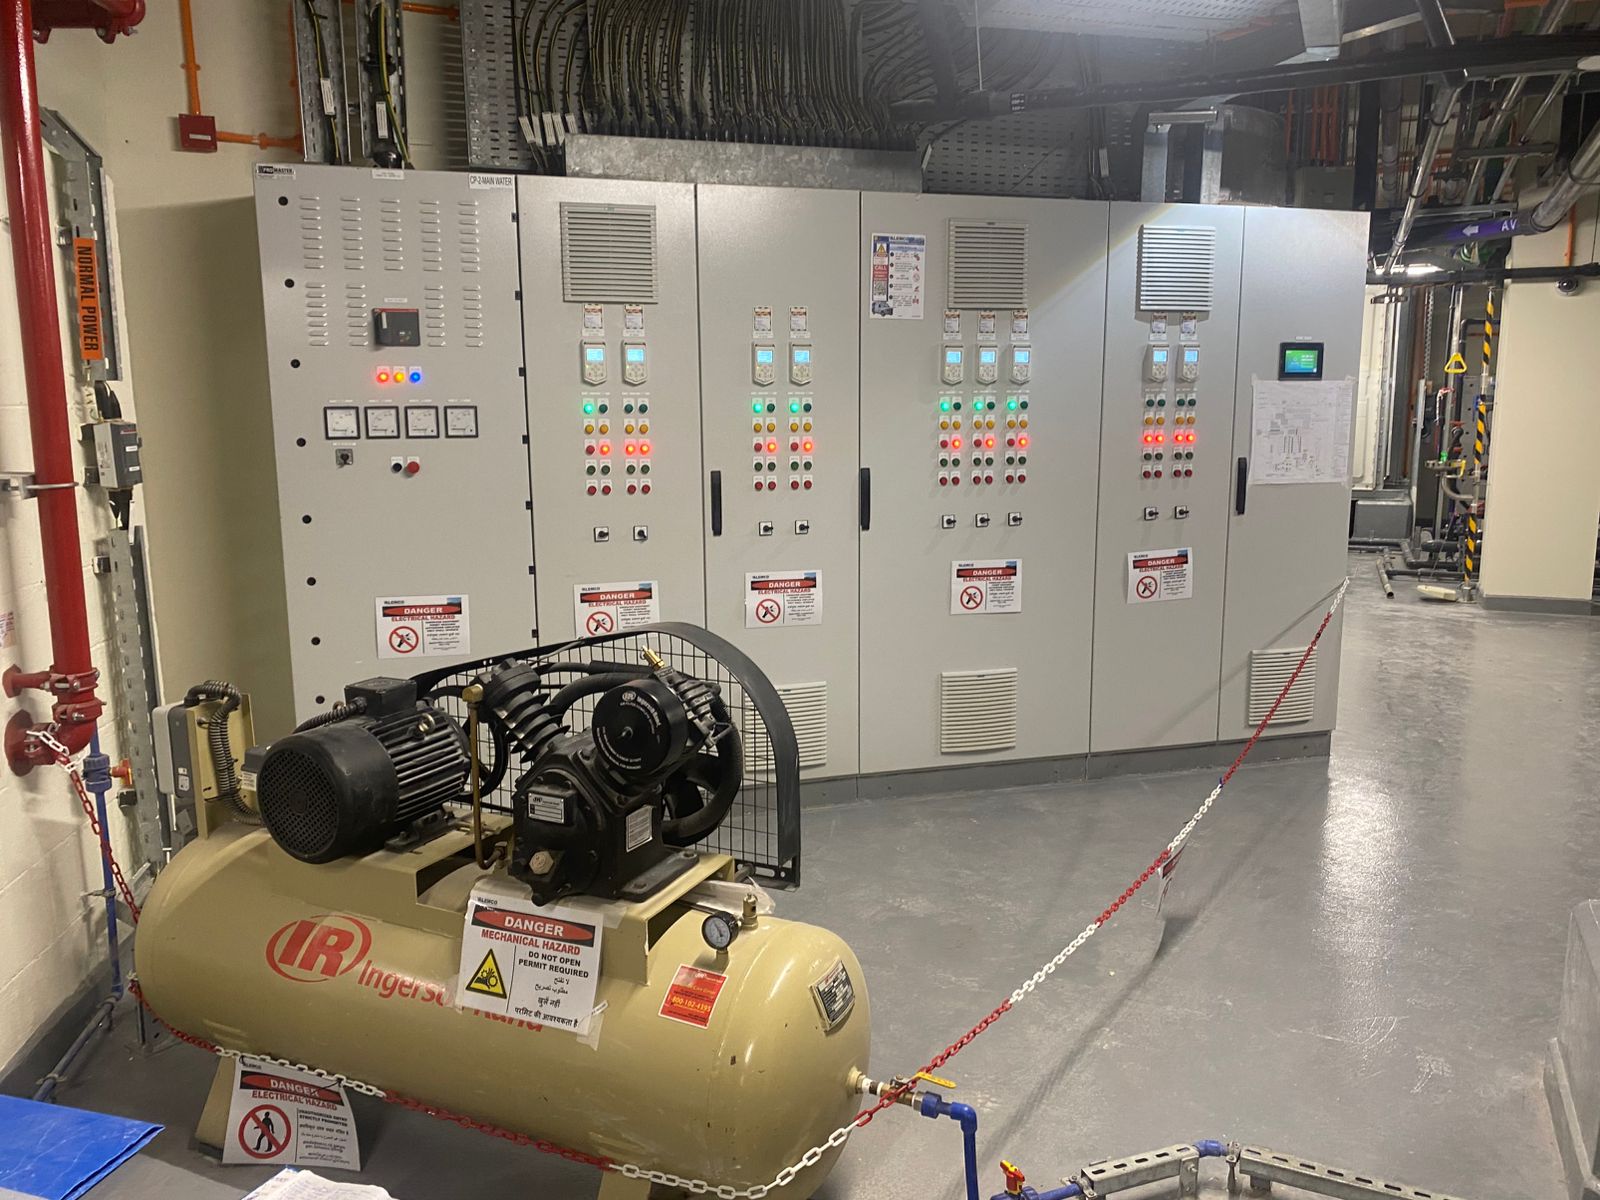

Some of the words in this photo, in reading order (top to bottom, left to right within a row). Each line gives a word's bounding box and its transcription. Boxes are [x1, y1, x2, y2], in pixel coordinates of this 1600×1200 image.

[495, 176, 512, 185] WATER
[1501, 219, 1517, 231] AV
[77, 246, 95, 301] NORMAL
[81, 306, 98, 350] POWER
[504, 916, 564, 937] DANGER
[278, 919, 355, 978] IR
[481, 929, 540, 948] MECHANICAL
[542, 940, 581, 956] HAZARD
[518, 958, 547, 971] PERMIT
[549, 964, 589, 979] REQUIRED
[528, 951, 540, 959] DO
[541, 953, 558, 963] NOT
[559, 957, 581, 967] OPEN
[270, 1079, 320, 1098] DANGER
[251, 1090, 304, 1104] ELECTRICAL
[305, 1097, 338, 1111] HAZARD
